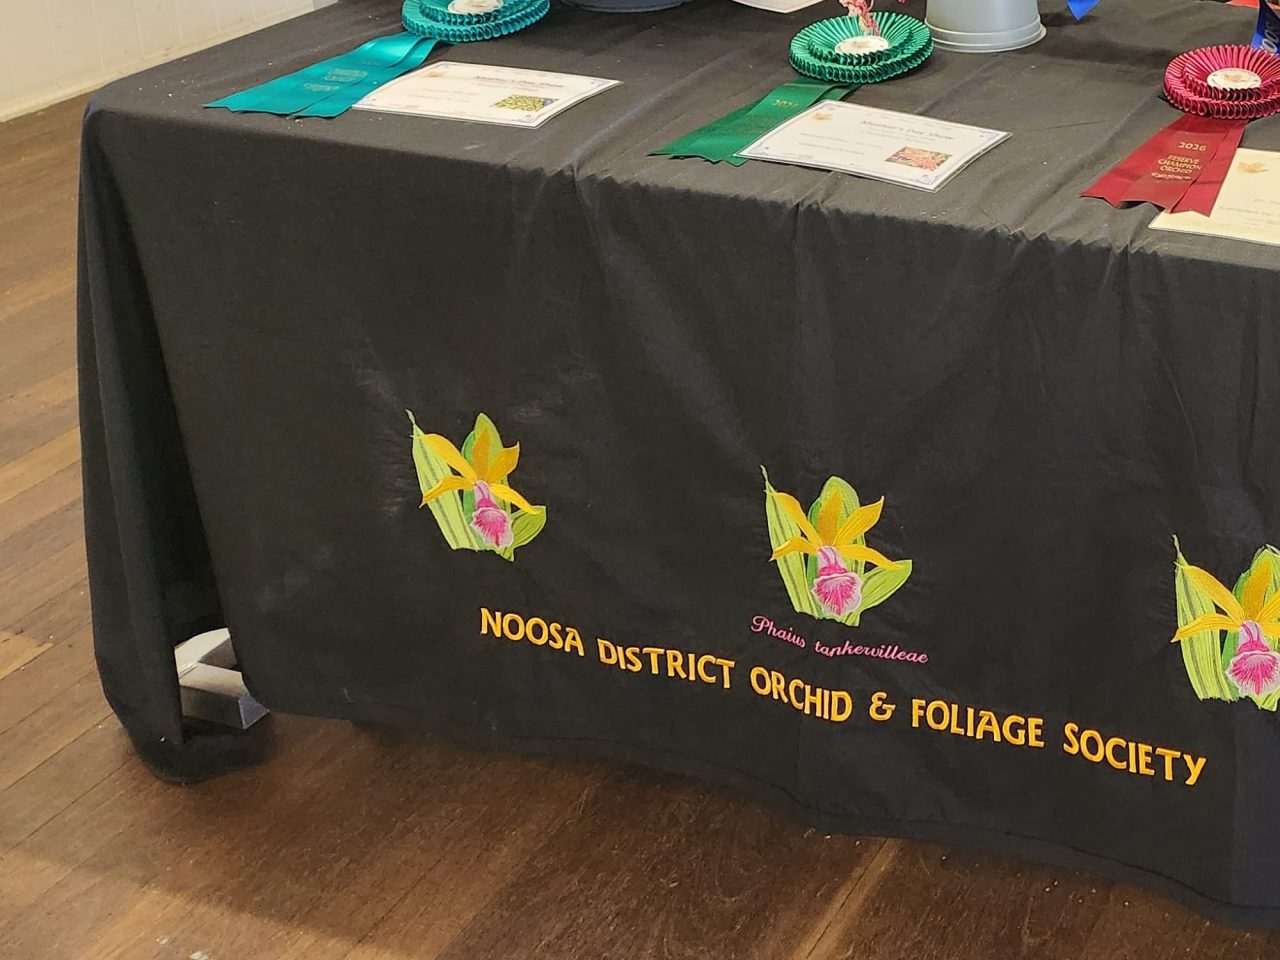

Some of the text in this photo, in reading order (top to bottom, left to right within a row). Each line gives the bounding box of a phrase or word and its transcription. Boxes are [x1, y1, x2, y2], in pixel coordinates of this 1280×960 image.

[1178, 141, 1207, 152] 2026
[1157, 158, 1203, 170] CHAMPION
[1167, 154, 1201, 164] RESERVE
[1160, 165, 1193, 174] ORCHID
[750, 615, 929, 664] Phaius tankervilleae
[480, 607, 1207, 786] NOOSA DISTRICT ORCHID & FOLIAGE SOCIETY
